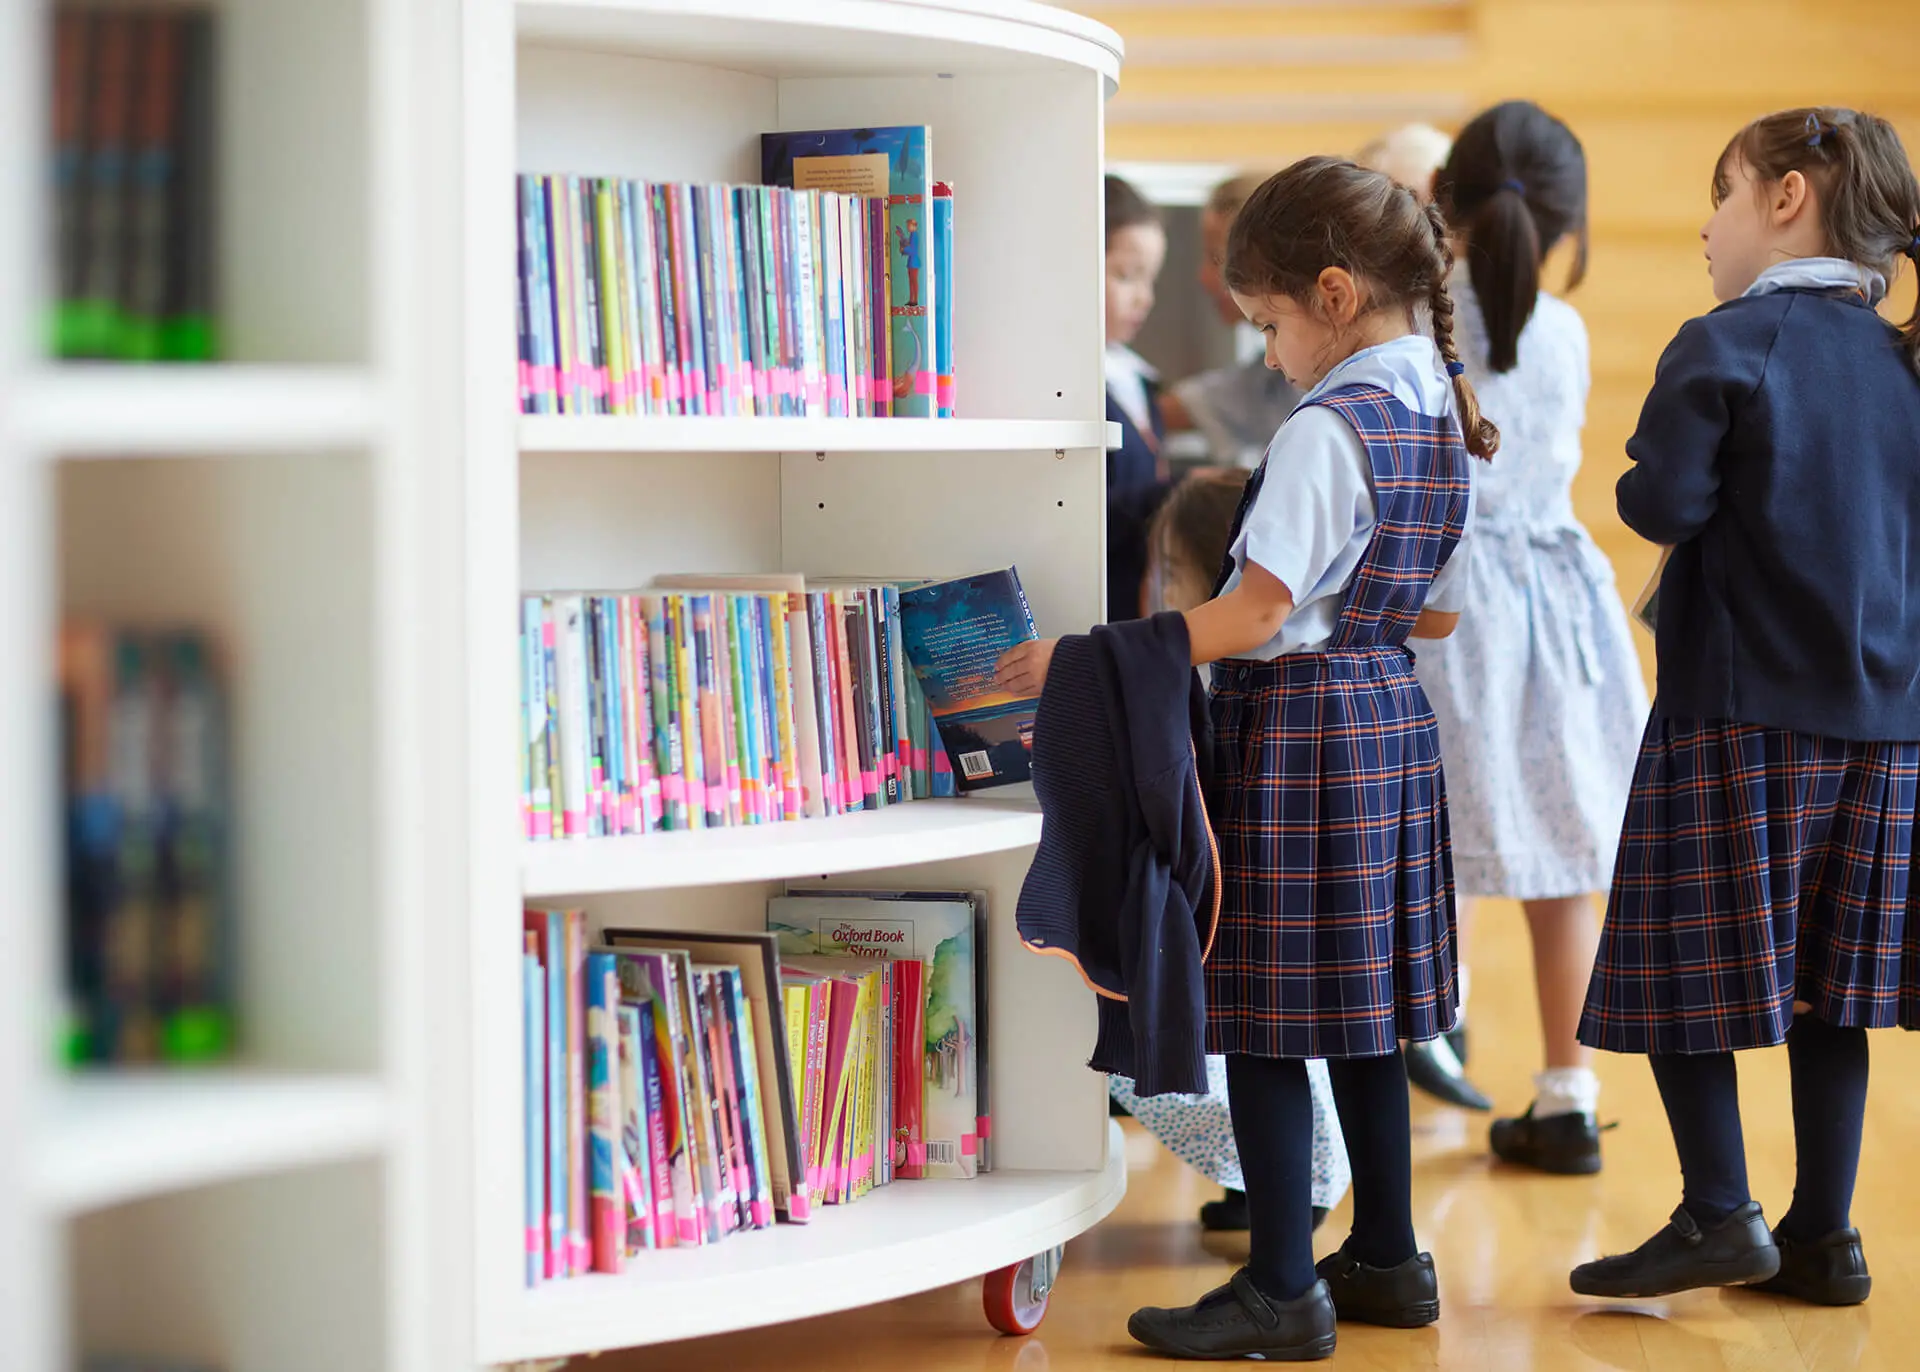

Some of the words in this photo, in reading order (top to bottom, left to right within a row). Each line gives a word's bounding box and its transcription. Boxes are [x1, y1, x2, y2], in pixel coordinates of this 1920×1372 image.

[1018, 591, 1032, 620] D-DAY
[832, 928, 872, 944] Oxford
[874, 928, 904, 942] Book
[850, 945, 888, 958] Story
